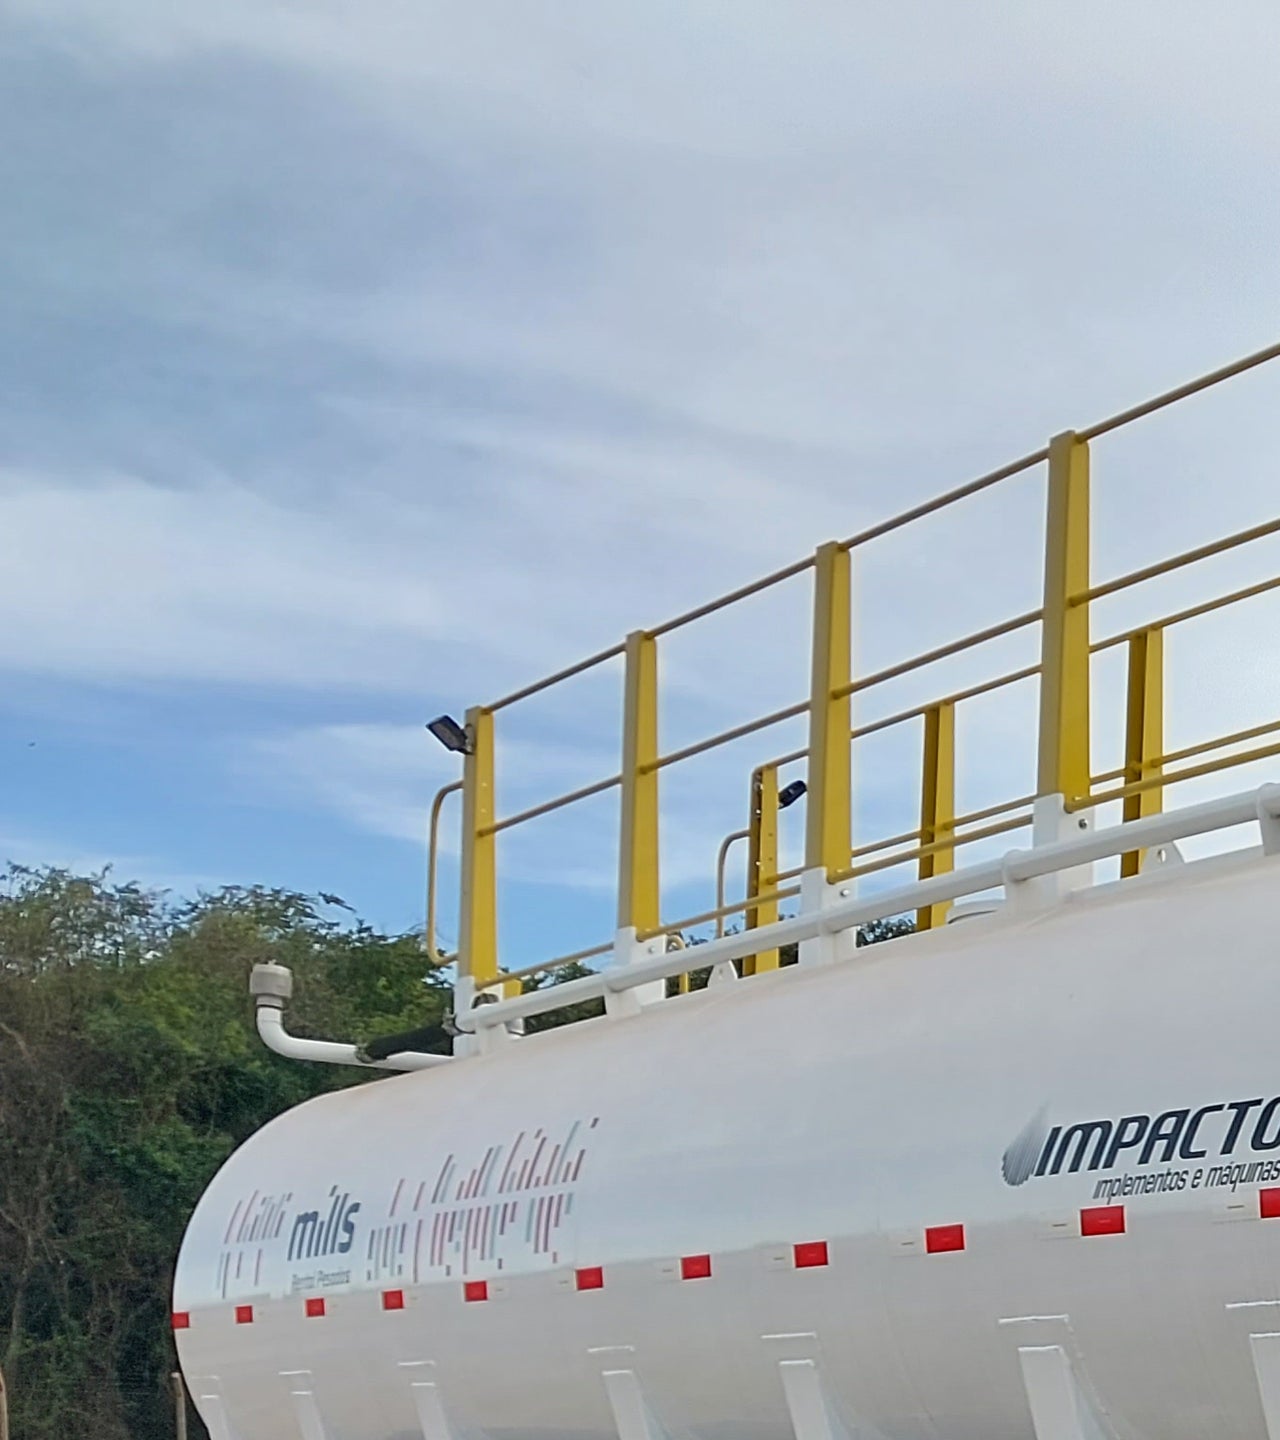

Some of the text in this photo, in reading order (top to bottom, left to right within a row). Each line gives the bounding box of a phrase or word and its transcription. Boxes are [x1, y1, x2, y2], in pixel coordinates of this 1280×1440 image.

[1092, 1166, 1189, 1205] implementos
[1190, 1168, 1203, 1189] e
[286, 1184, 362, 1262] mills
